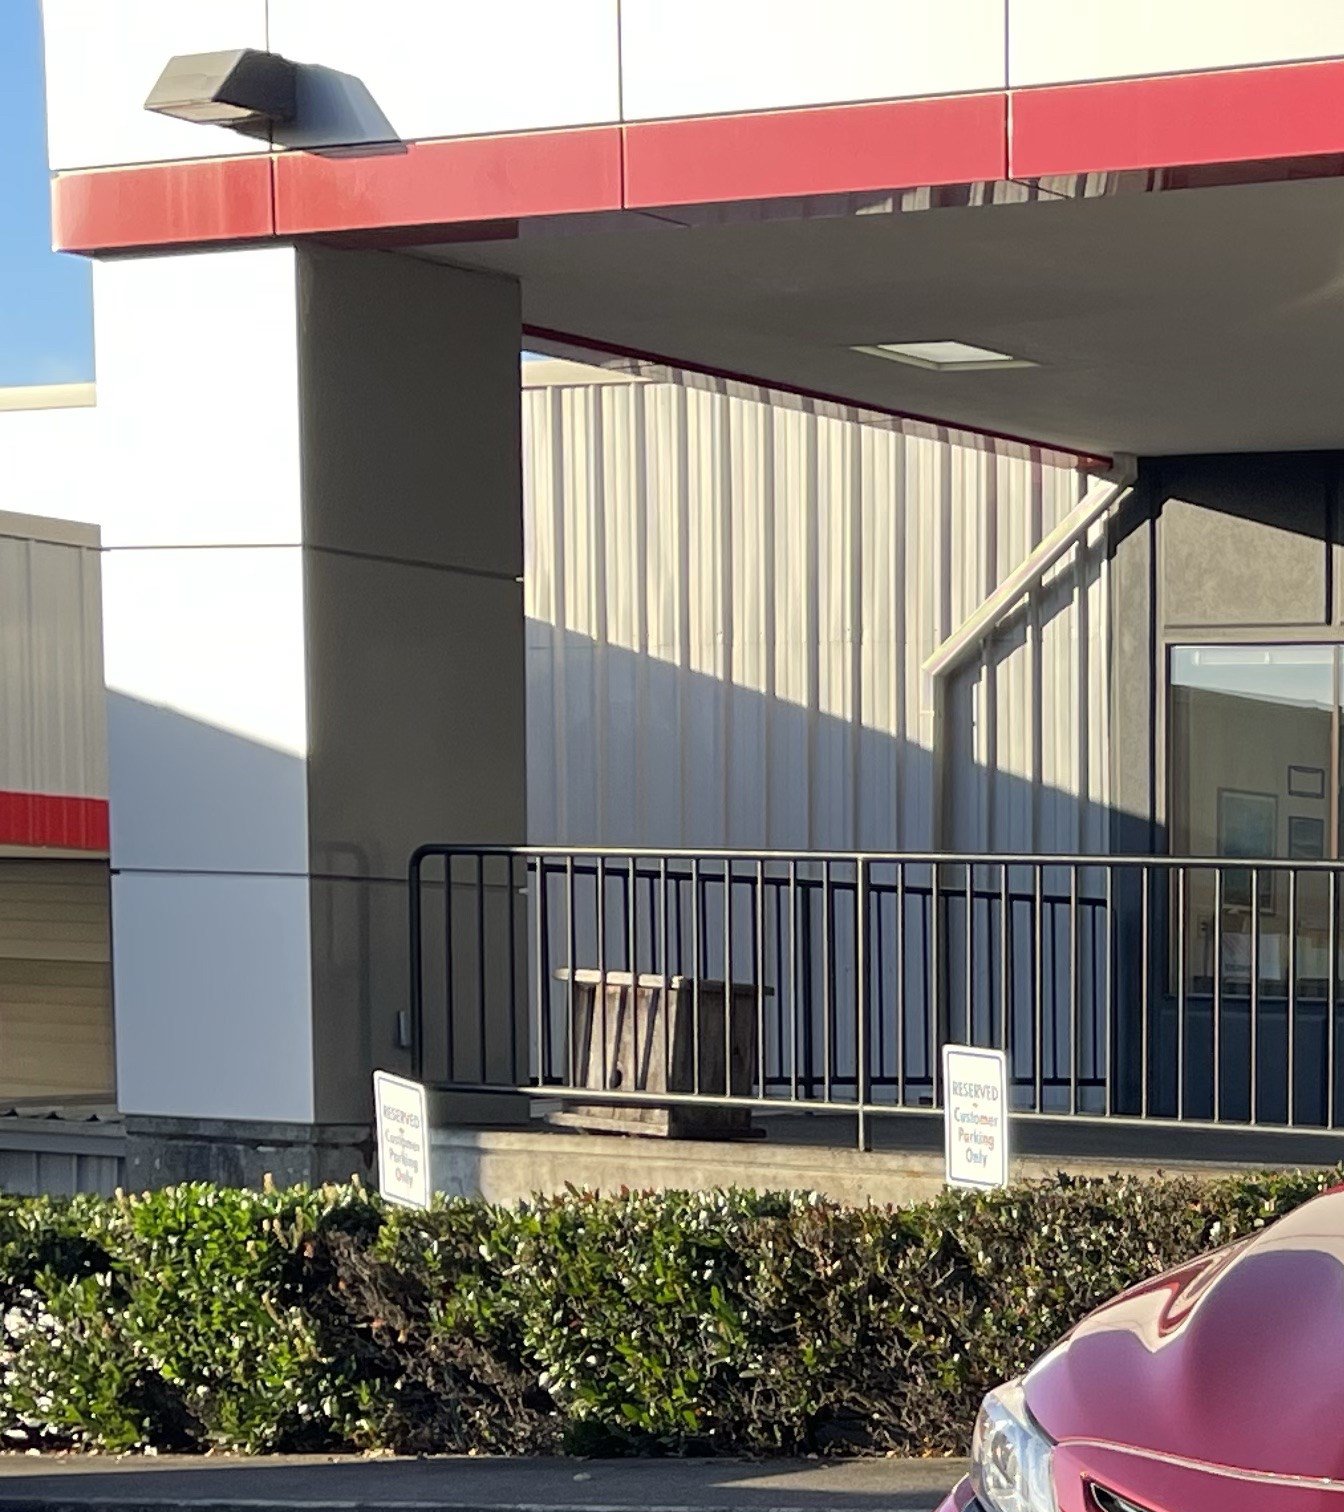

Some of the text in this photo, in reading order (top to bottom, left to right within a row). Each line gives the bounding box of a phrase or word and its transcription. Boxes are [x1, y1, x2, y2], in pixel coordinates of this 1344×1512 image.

[952, 1081, 998, 1101] RESERVED
[383, 1104, 420, 1129] RESERVED
[954, 1107, 998, 1127] Customer
[384, 1128, 420, 1152] Customer
[958, 1126, 995, 1151] Parking
[389, 1147, 418, 1174] Parking
[965, 1147, 988, 1168] Only
[395, 1167, 413, 1188] Only
